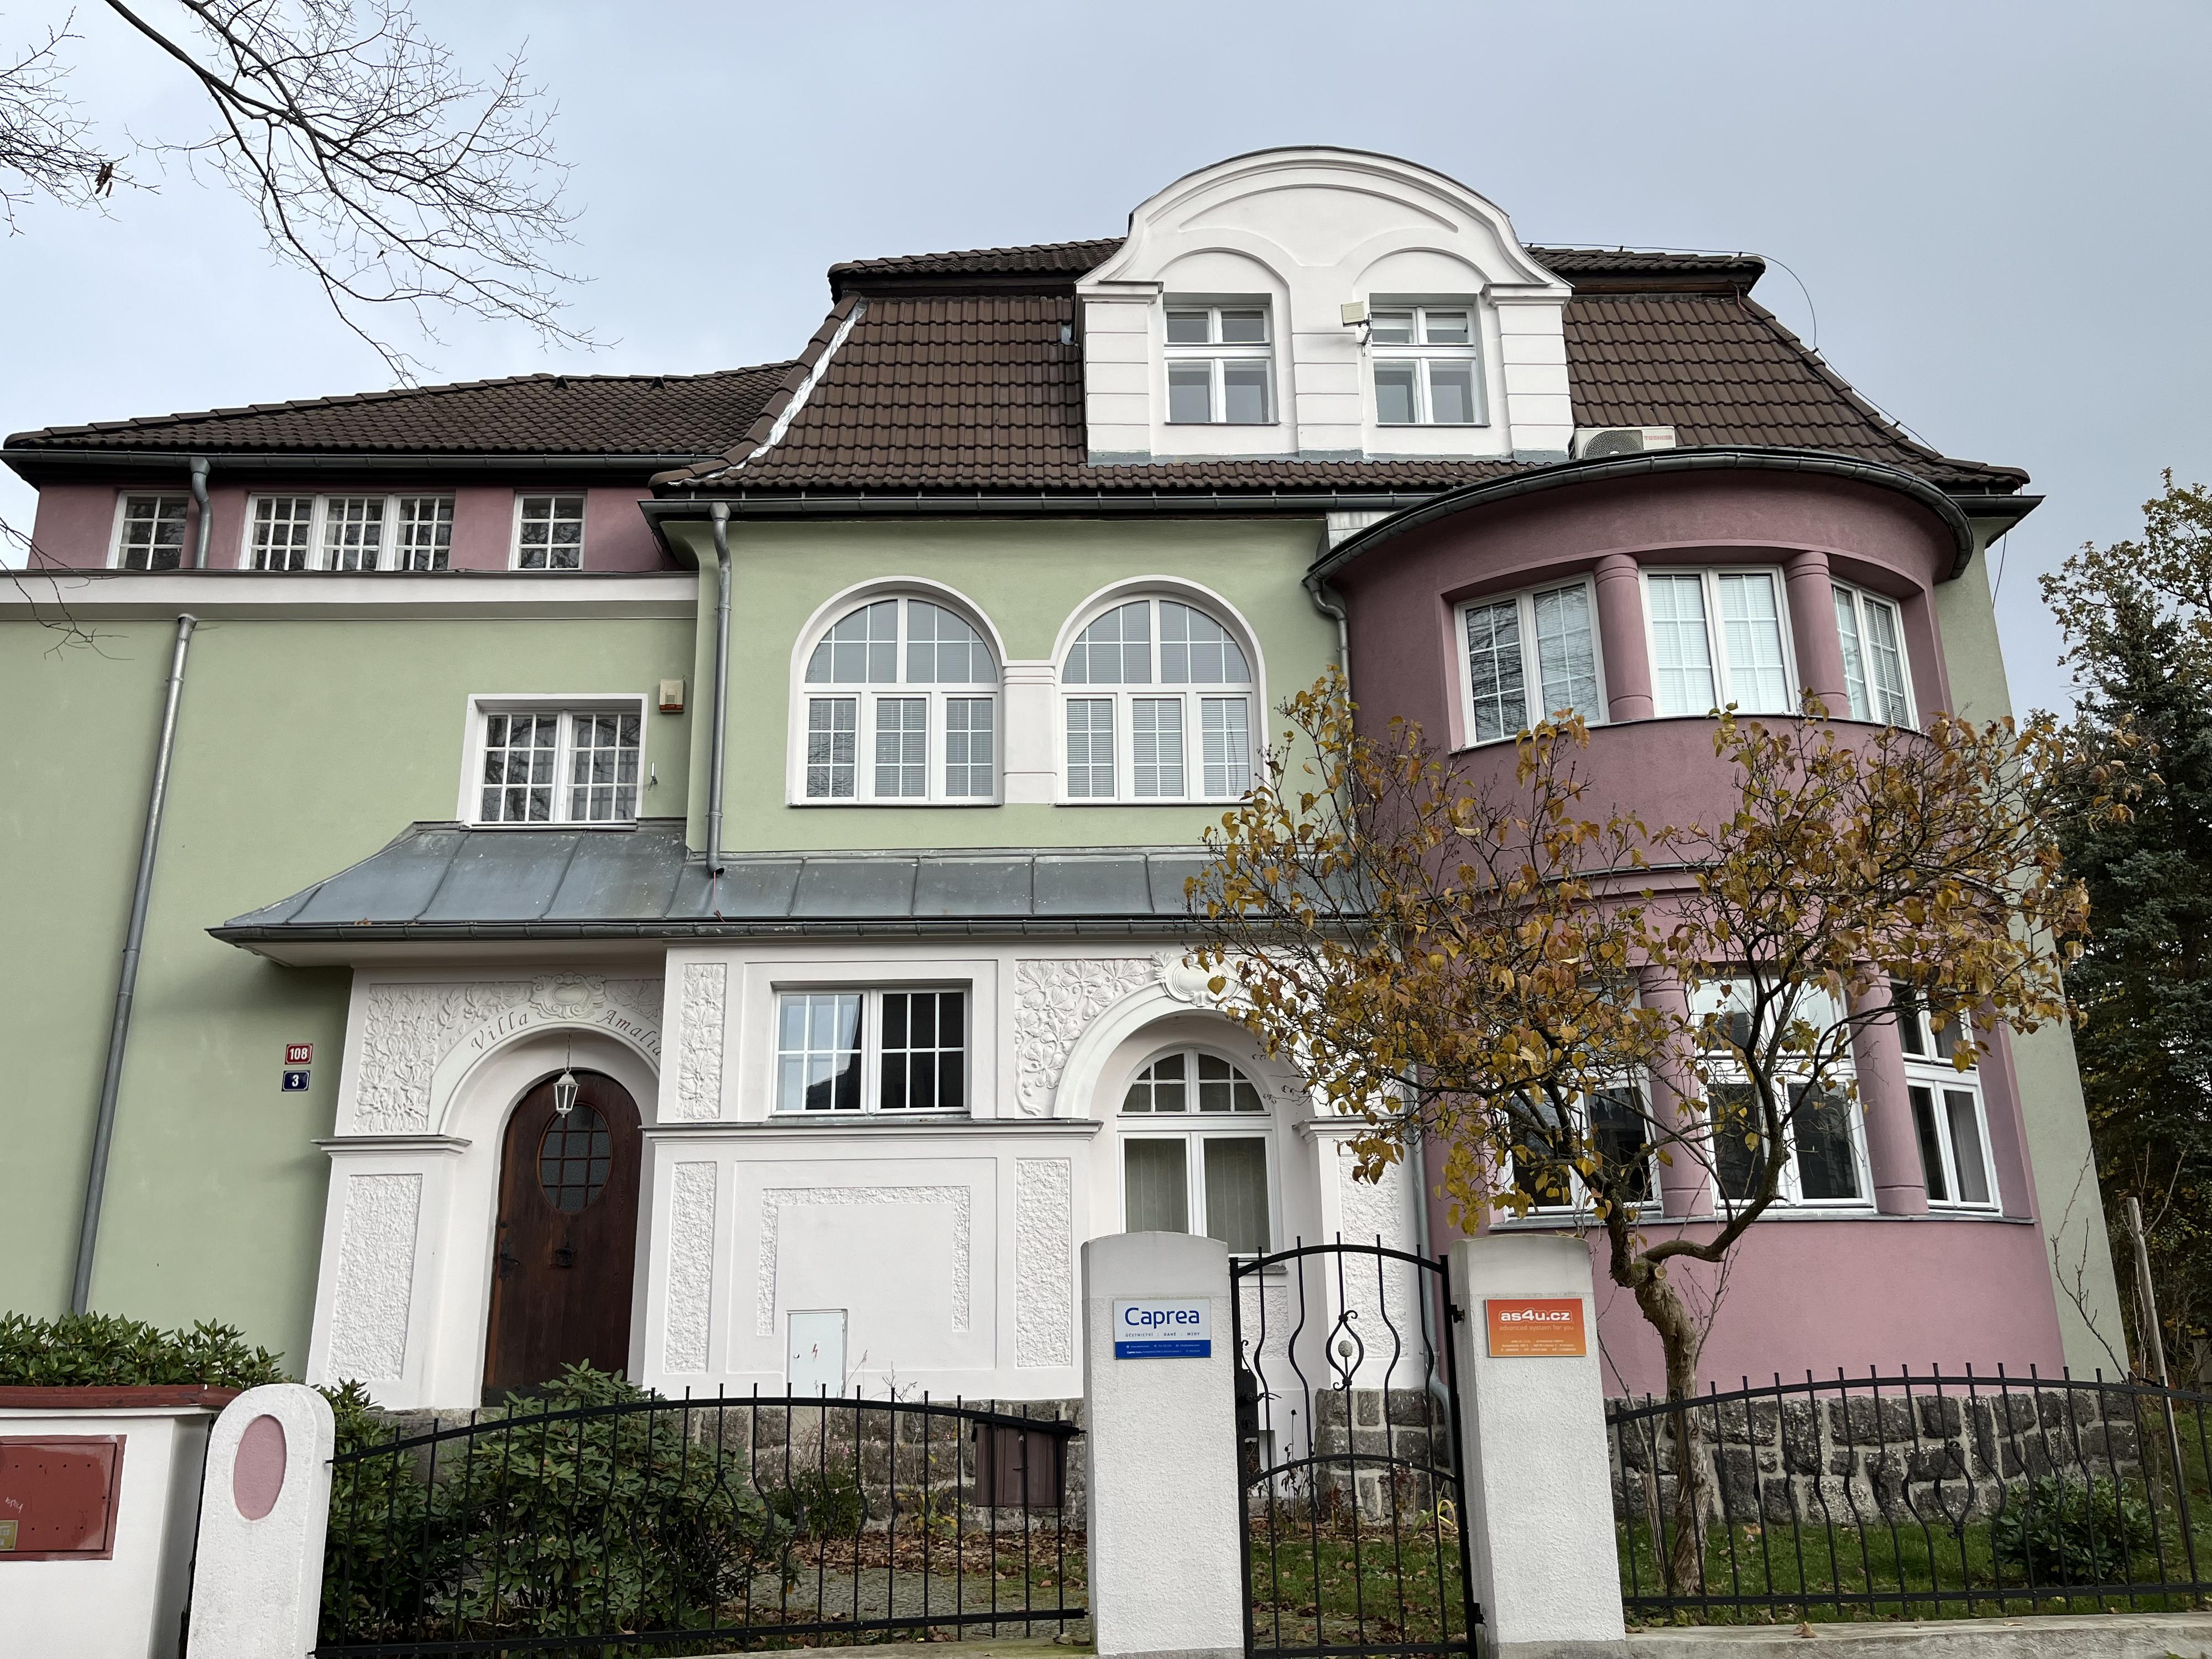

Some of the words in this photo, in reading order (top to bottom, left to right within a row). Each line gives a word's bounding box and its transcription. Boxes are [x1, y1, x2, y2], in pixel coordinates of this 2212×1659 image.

[471, 1011, 529, 1050] Villa
[596, 1009, 661, 1056] Amalia
[290, 1047, 307, 1060] 108
[292, 1074, 299, 1087] 3
[1125, 1307, 1199, 1329] Caprea
[1500, 1310, 1571, 1321] as4u.cz
